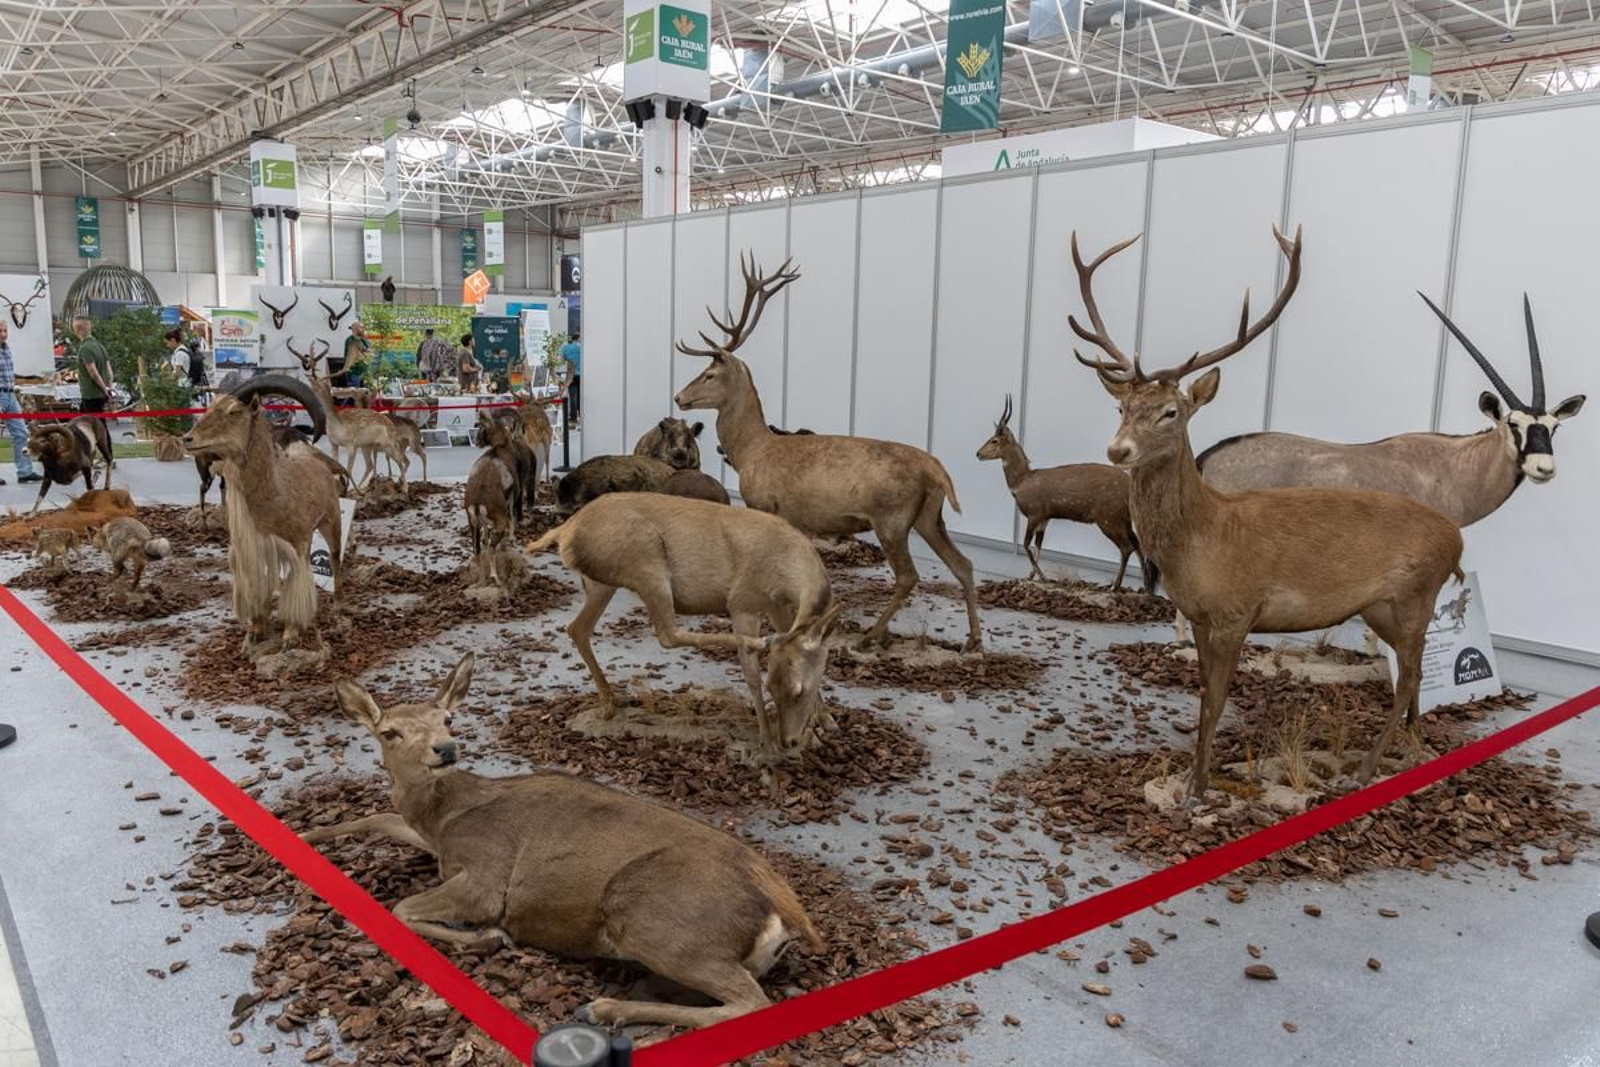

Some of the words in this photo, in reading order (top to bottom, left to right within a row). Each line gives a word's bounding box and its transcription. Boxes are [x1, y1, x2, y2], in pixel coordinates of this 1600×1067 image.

[660, 35, 680, 47] CAJA
[680, 38, 706, 53] RURAL
[946, 84, 967, 96] CAJA
[967, 80, 997, 94] RURAL
[1016, 148, 1040, 159] Junta
[1016, 160, 1026, 170] de
[1028, 153, 1070, 169] Andalucía
